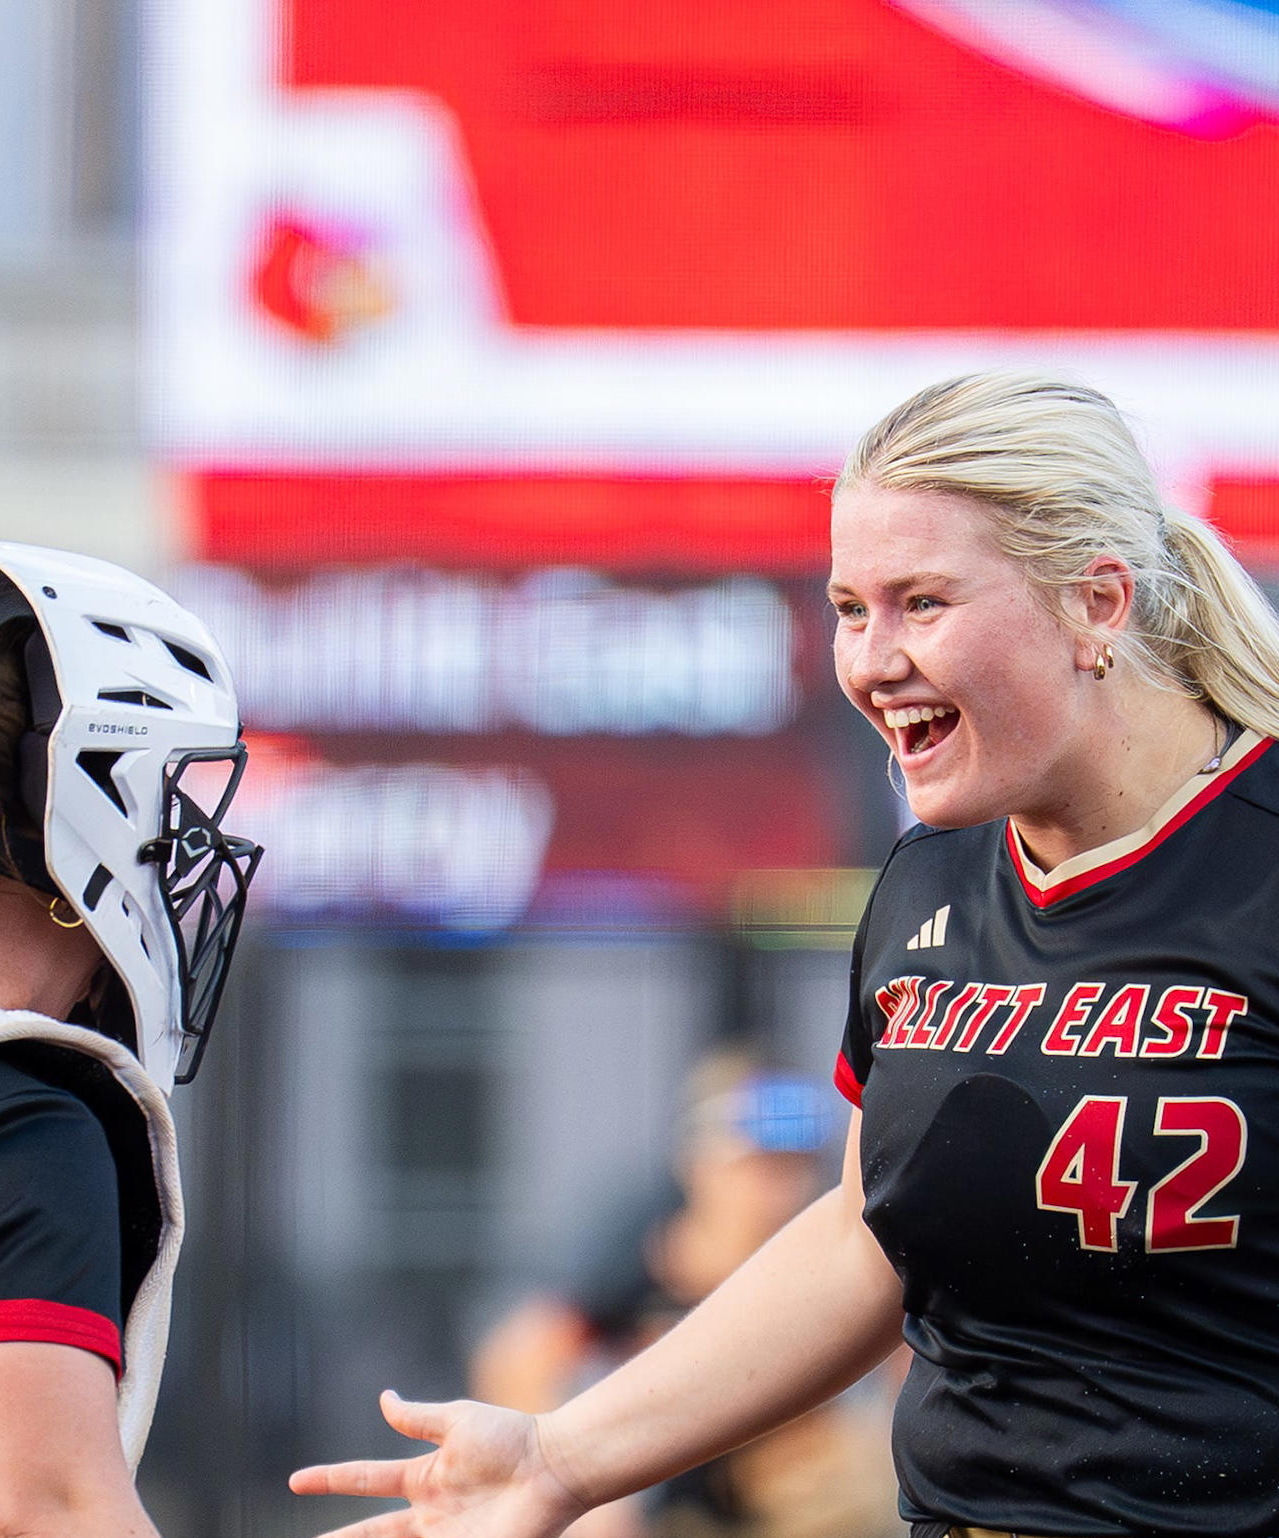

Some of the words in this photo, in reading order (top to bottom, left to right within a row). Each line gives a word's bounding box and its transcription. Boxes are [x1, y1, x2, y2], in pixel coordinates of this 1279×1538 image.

[88, 723, 149, 735] EVOSHIELD
[1040, 981, 1249, 1060] EAST
[1035, 1094, 1249, 1255] 42
